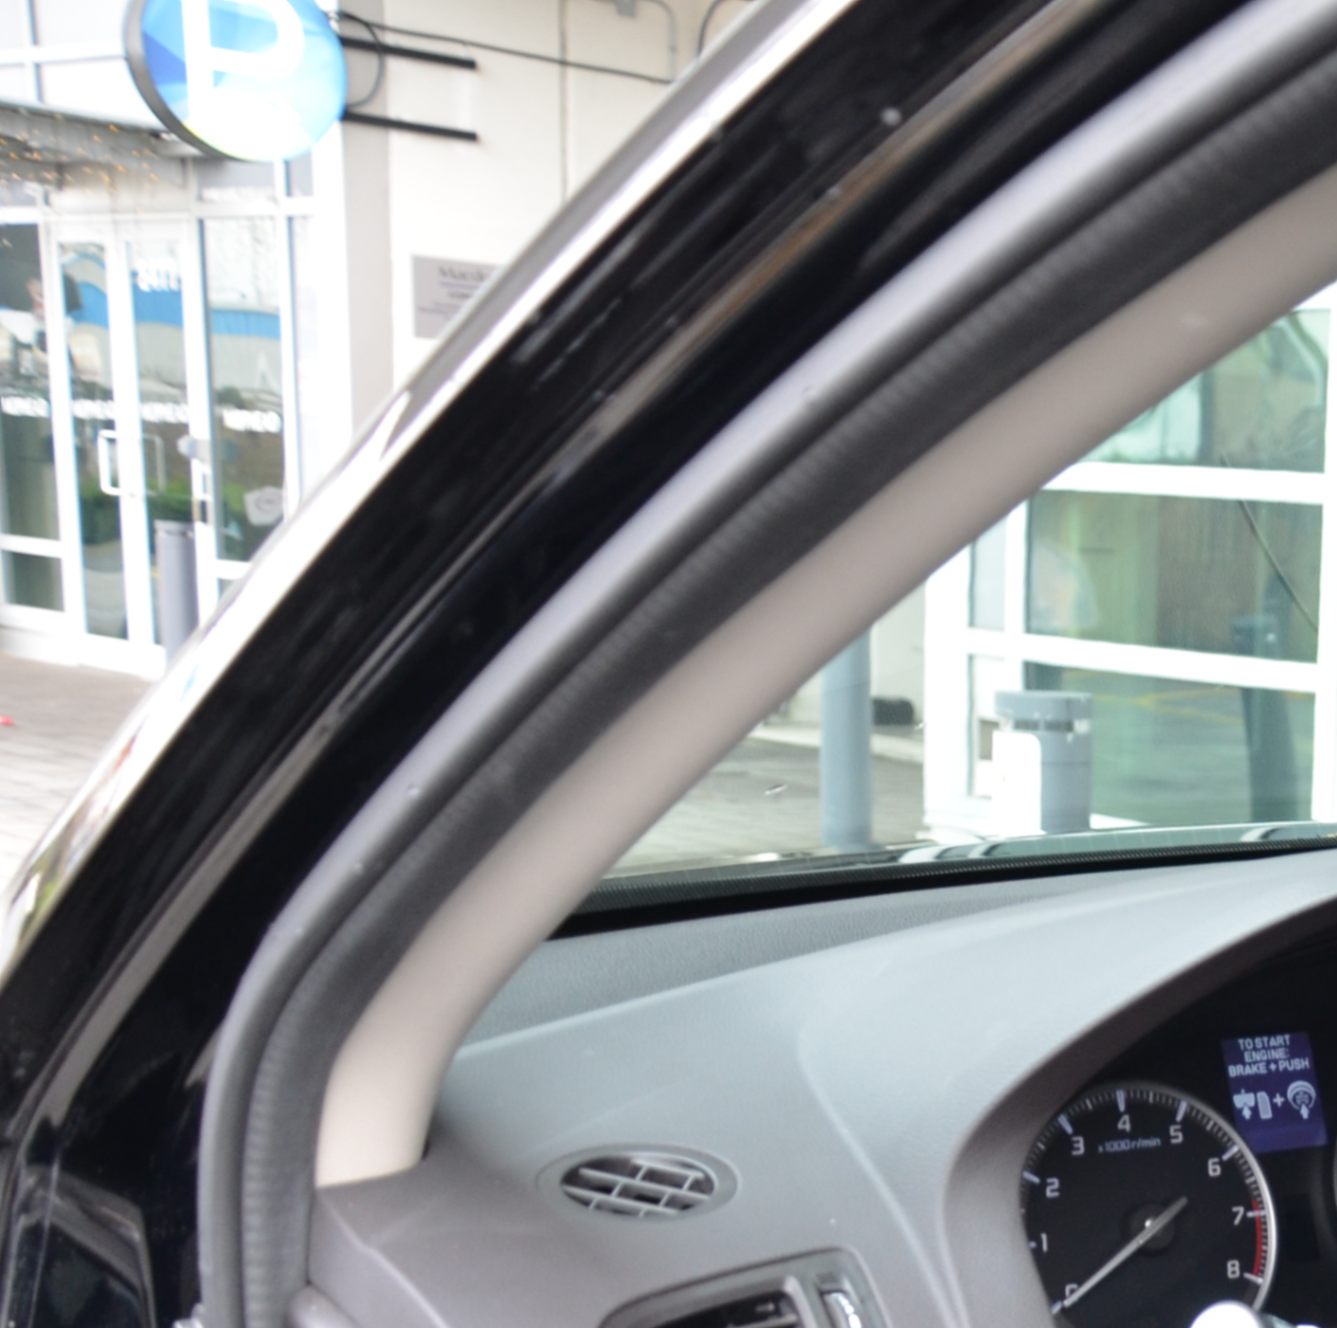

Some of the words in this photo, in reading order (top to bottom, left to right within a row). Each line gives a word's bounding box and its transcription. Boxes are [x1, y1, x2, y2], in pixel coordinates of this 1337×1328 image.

[1238, 1038, 1253, 1050] TO
[1254, 1034, 1290, 1048] START
[1228, 1061, 1267, 1077] BRAKE
[1278, 1057, 1310, 1071] PUSH
[1117, 1114, 1131, 1132] 4
[1169, 1125, 1184, 1144] 5
[1071, 1136, 1085, 1155] 3
[1207, 1157, 1222, 1177] 6
[1045, 1178, 1060, 1198] 2
[1232, 1206, 1245, 1226] 7
[1041, 1233, 1048, 1253] 1
[1227, 1260, 1240, 1279] 8
